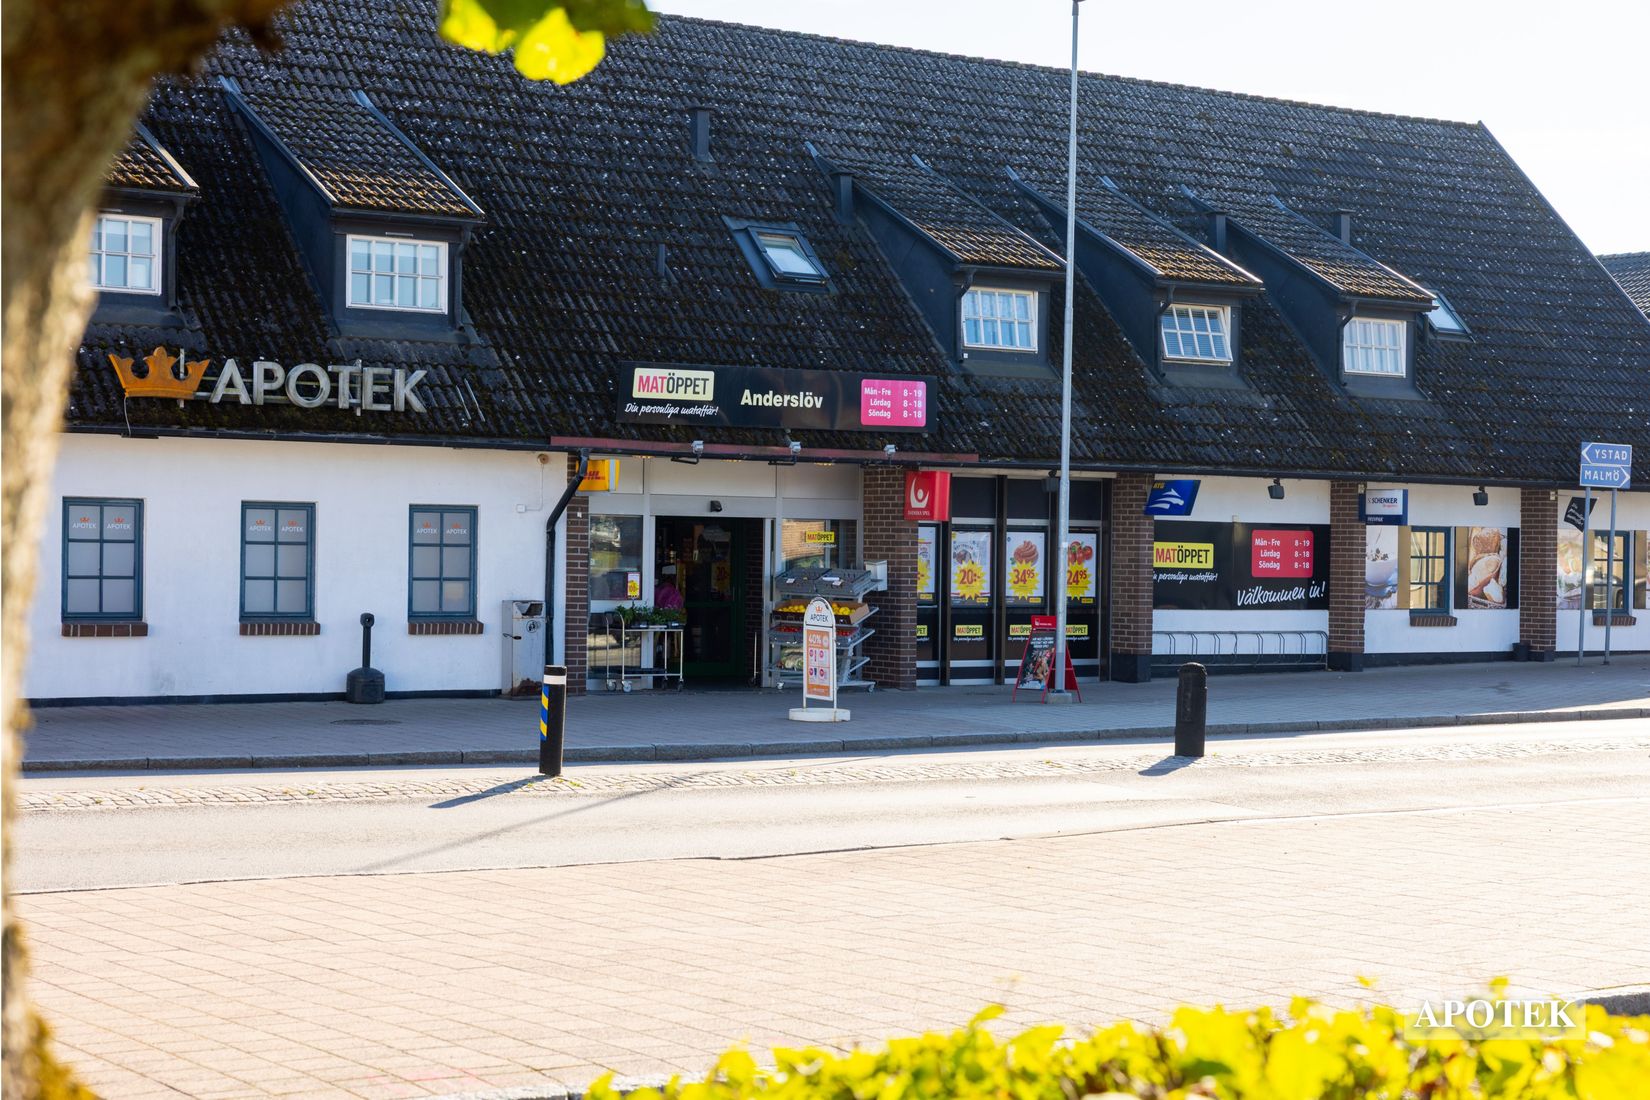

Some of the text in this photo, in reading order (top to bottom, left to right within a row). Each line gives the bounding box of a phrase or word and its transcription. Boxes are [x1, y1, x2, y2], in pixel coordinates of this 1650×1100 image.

[209, 358, 428, 413] APOTEK
[638, 372, 709, 395] MATÖPPET
[864, 387, 878, 395] Mån
[882, 388, 892, 396] Fre
[903, 389, 909, 397] 8
[914, 390, 923, 398] 19
[741, 389, 823, 408] Anderslöv
[870, 399, 892, 409] Lördag
[903, 400, 909, 408] 8
[625, 402, 719, 418] Din personliga mataffär!
[868, 409, 892, 419] Söndag
[903, 410, 909, 418] 8
[914, 411, 923, 419] 18
[1595, 449, 1628, 461] YSTAD
[1584, 470, 1620, 481] MALMÖ
[1255, 538, 1268, 546] Mån
[1155, 545, 1211, 564] MATÖPPET
[1260, 550, 1281, 559] Lördag
[1259, 561, 1281, 570] Söndag
[1237, 581, 1325, 606] Välkommen in!
[811, 614, 829, 622] APOTEK
